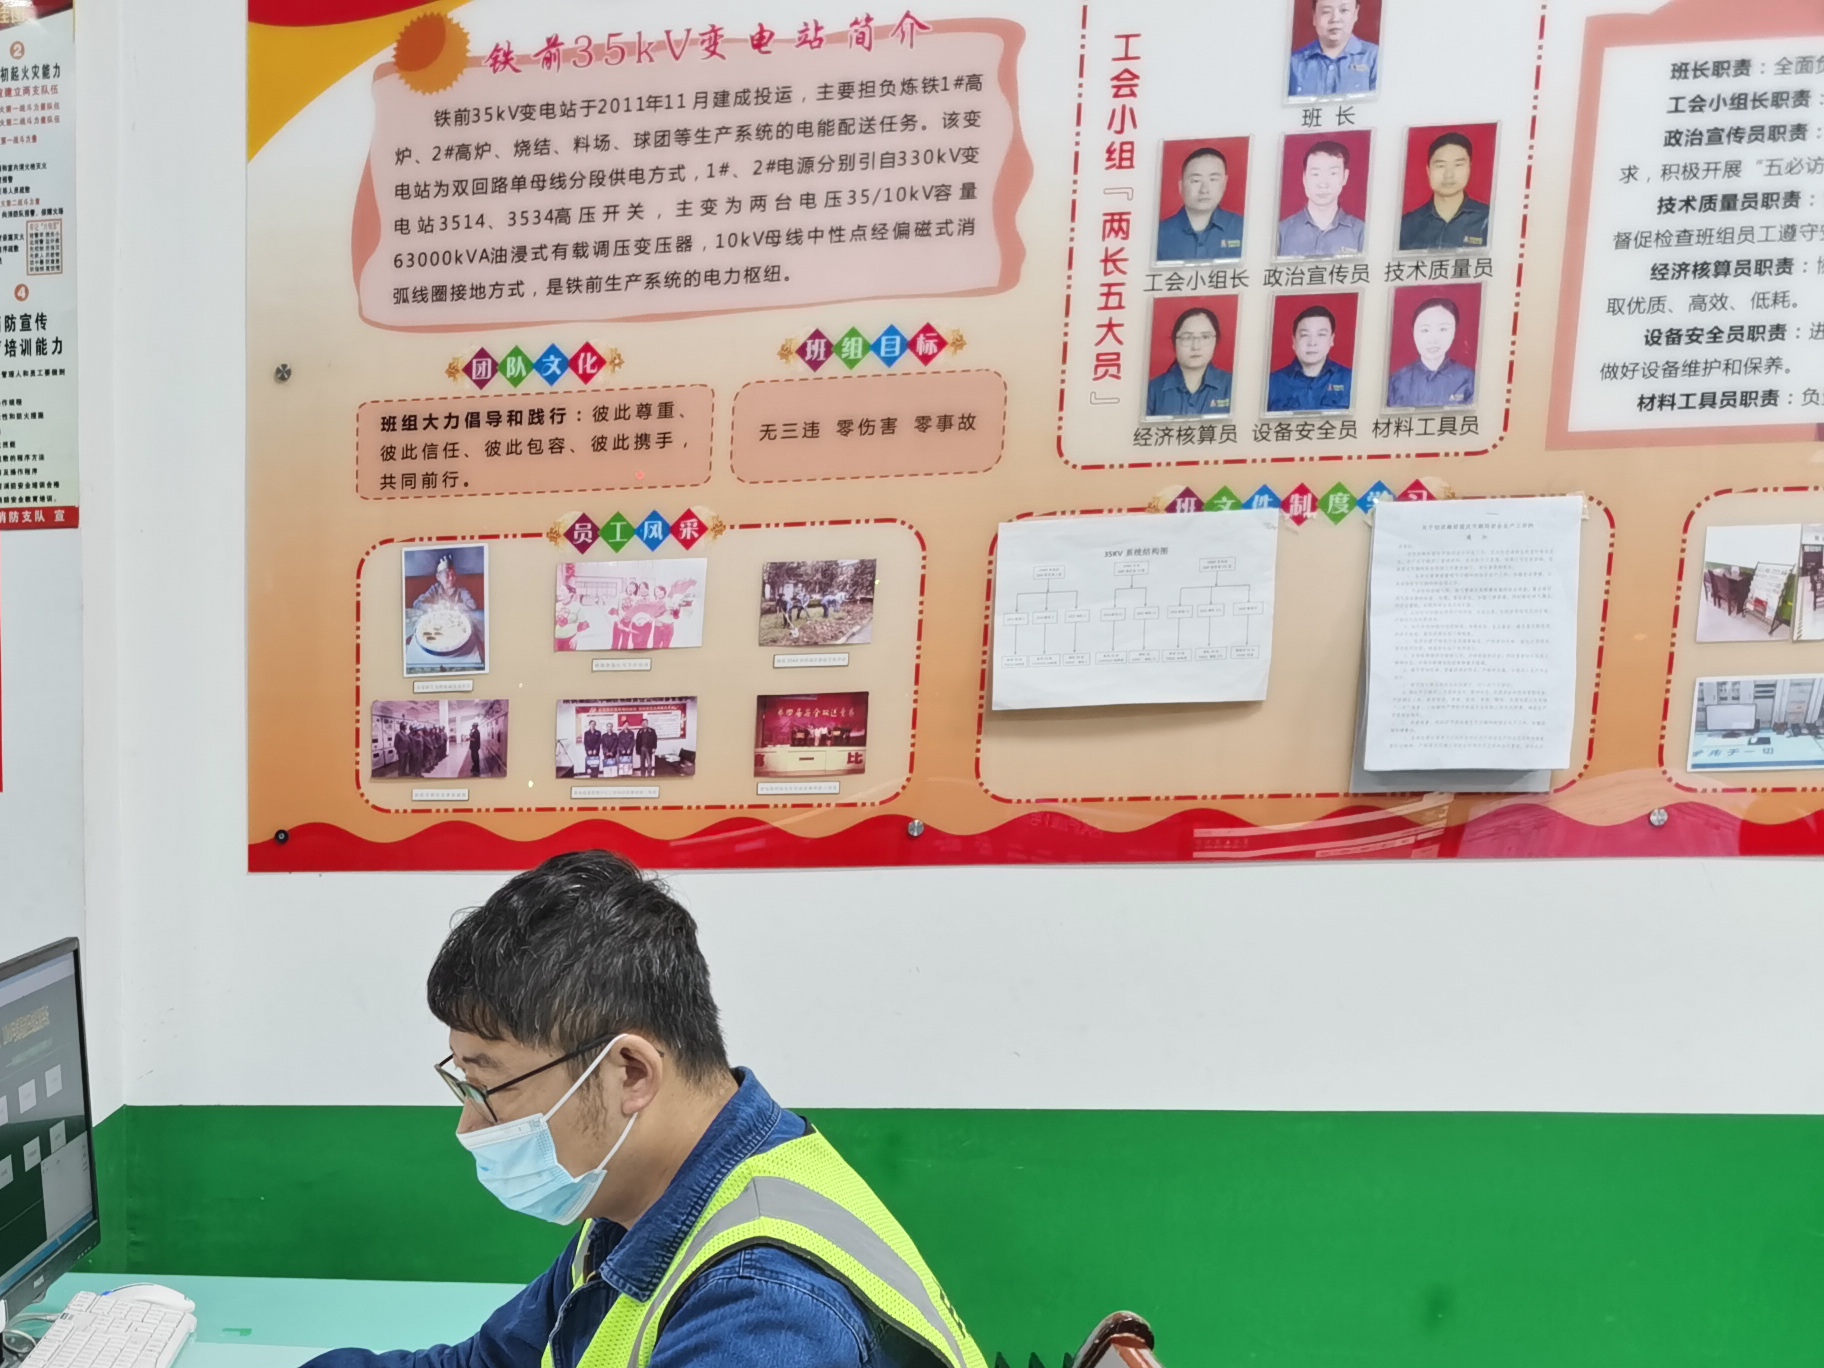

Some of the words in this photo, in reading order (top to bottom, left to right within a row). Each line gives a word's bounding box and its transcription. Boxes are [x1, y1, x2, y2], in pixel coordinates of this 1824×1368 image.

[482, 8, 933, 77] 铁前35kV变电站简介
[1613, 223, 1824, 251] 督促检查班组员工遵守
[1143, 268, 1250, 293] 工会小组长
[1263, 263, 1370, 288] 政治宣传员
[1384, 258, 1494, 283] 技术质量员
[1606, 290, 1799, 316] 取优质、高效、低耗。
[804, 331, 941, 363] 班组目标
[471, 350, 601, 382] 团队文化
[1600, 355, 1793, 381] 做好设备维护和保养。
[1637, 387, 1824, 412] 材料工具员职责：负
[759, 418, 821, 441] 无三违
[835, 415, 899, 438] 零伤害
[914, 412, 978, 435] 零事故
[1133, 423, 1238, 447] 经济核算员
[1252, 418, 1358, 442] 设备安全员
[1371, 415, 1480, 438] 材料工具员
[380, 470, 471, 491] 共同前行。
[54, 509, 65, 522] 宣
[573, 517, 700, 546] 员工风采
